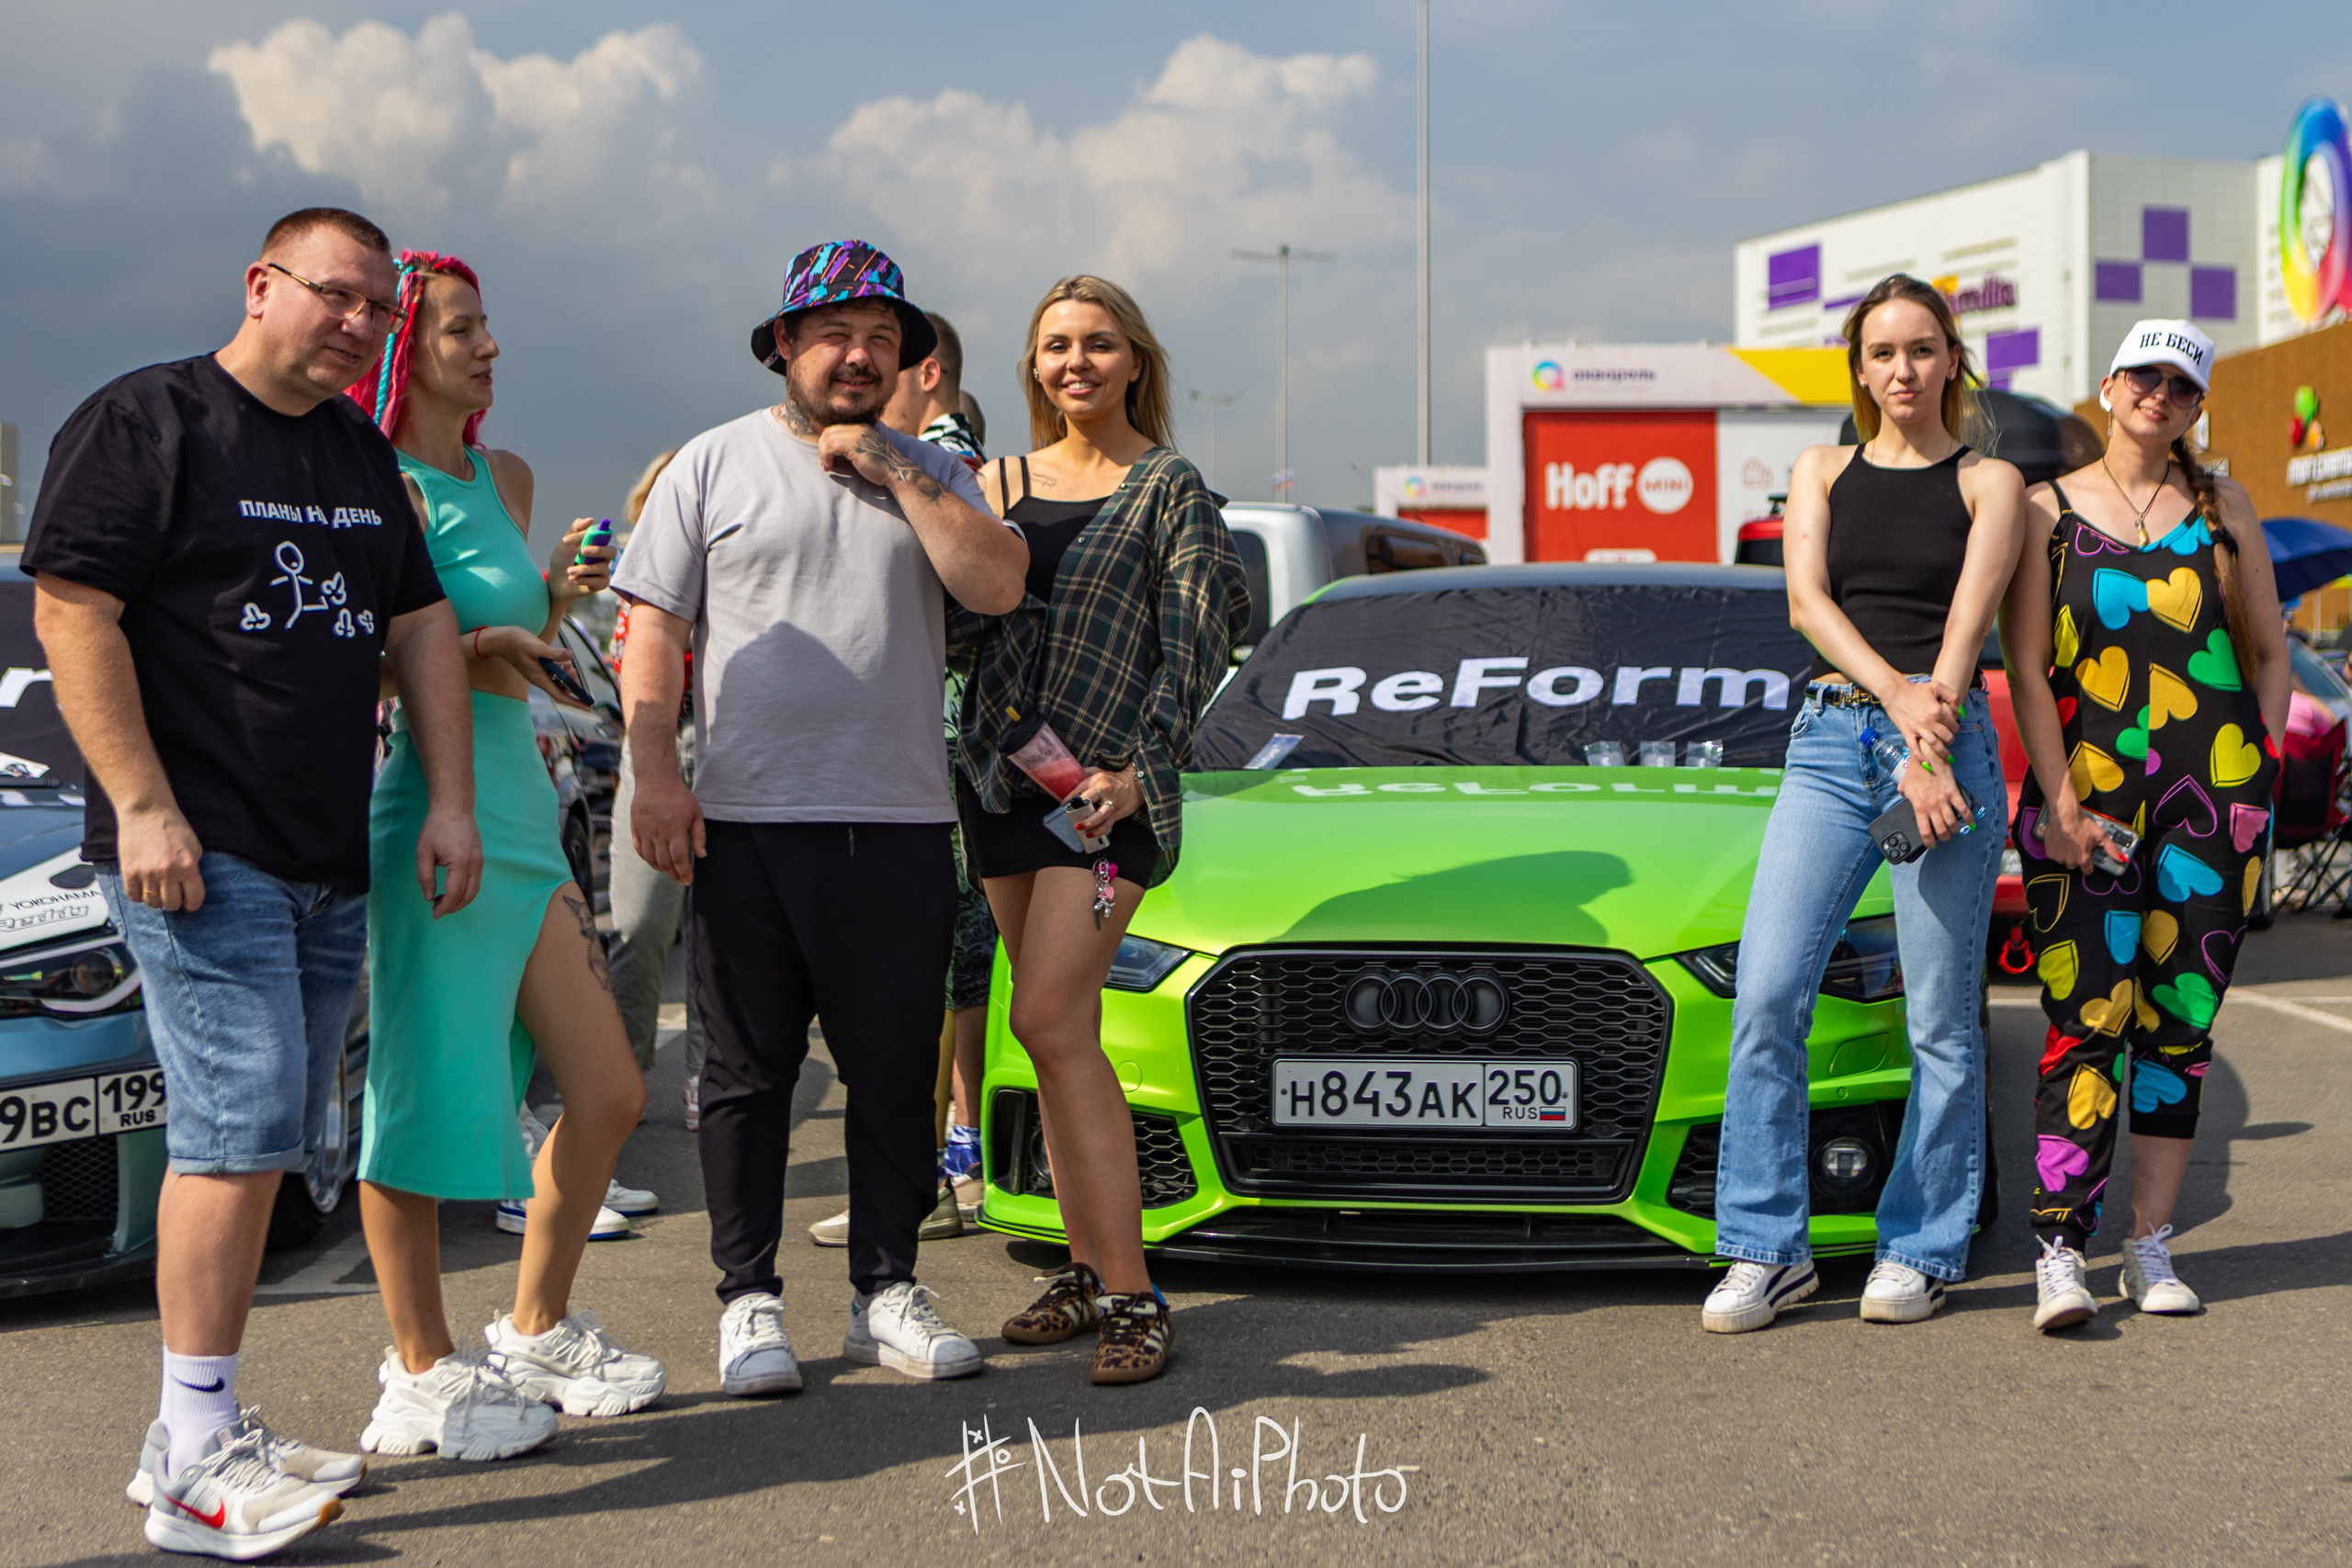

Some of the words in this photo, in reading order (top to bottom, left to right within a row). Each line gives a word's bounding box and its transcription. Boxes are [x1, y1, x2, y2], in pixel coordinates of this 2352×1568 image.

[2140, 332, 2162, 348] НЕ
[2165, 333, 2204, 367] БЕСИ
[1544, 461, 1635, 511] Hoff
[1645, 476, 1688, 491] MINI
[238, 500, 303, 524] ПЛАНЫ
[331, 506, 382, 529] ДЕНЬ
[1281, 656, 1791, 721] ReForm
[9, 890, 104, 910] YOKOHAMA
[1290, 1069, 1477, 1118] Н843АК
[1488, 1069, 1562, 1106] 250
[120, 1109, 156, 1128] RUS
[1502, 1106, 1538, 1120] RUS
